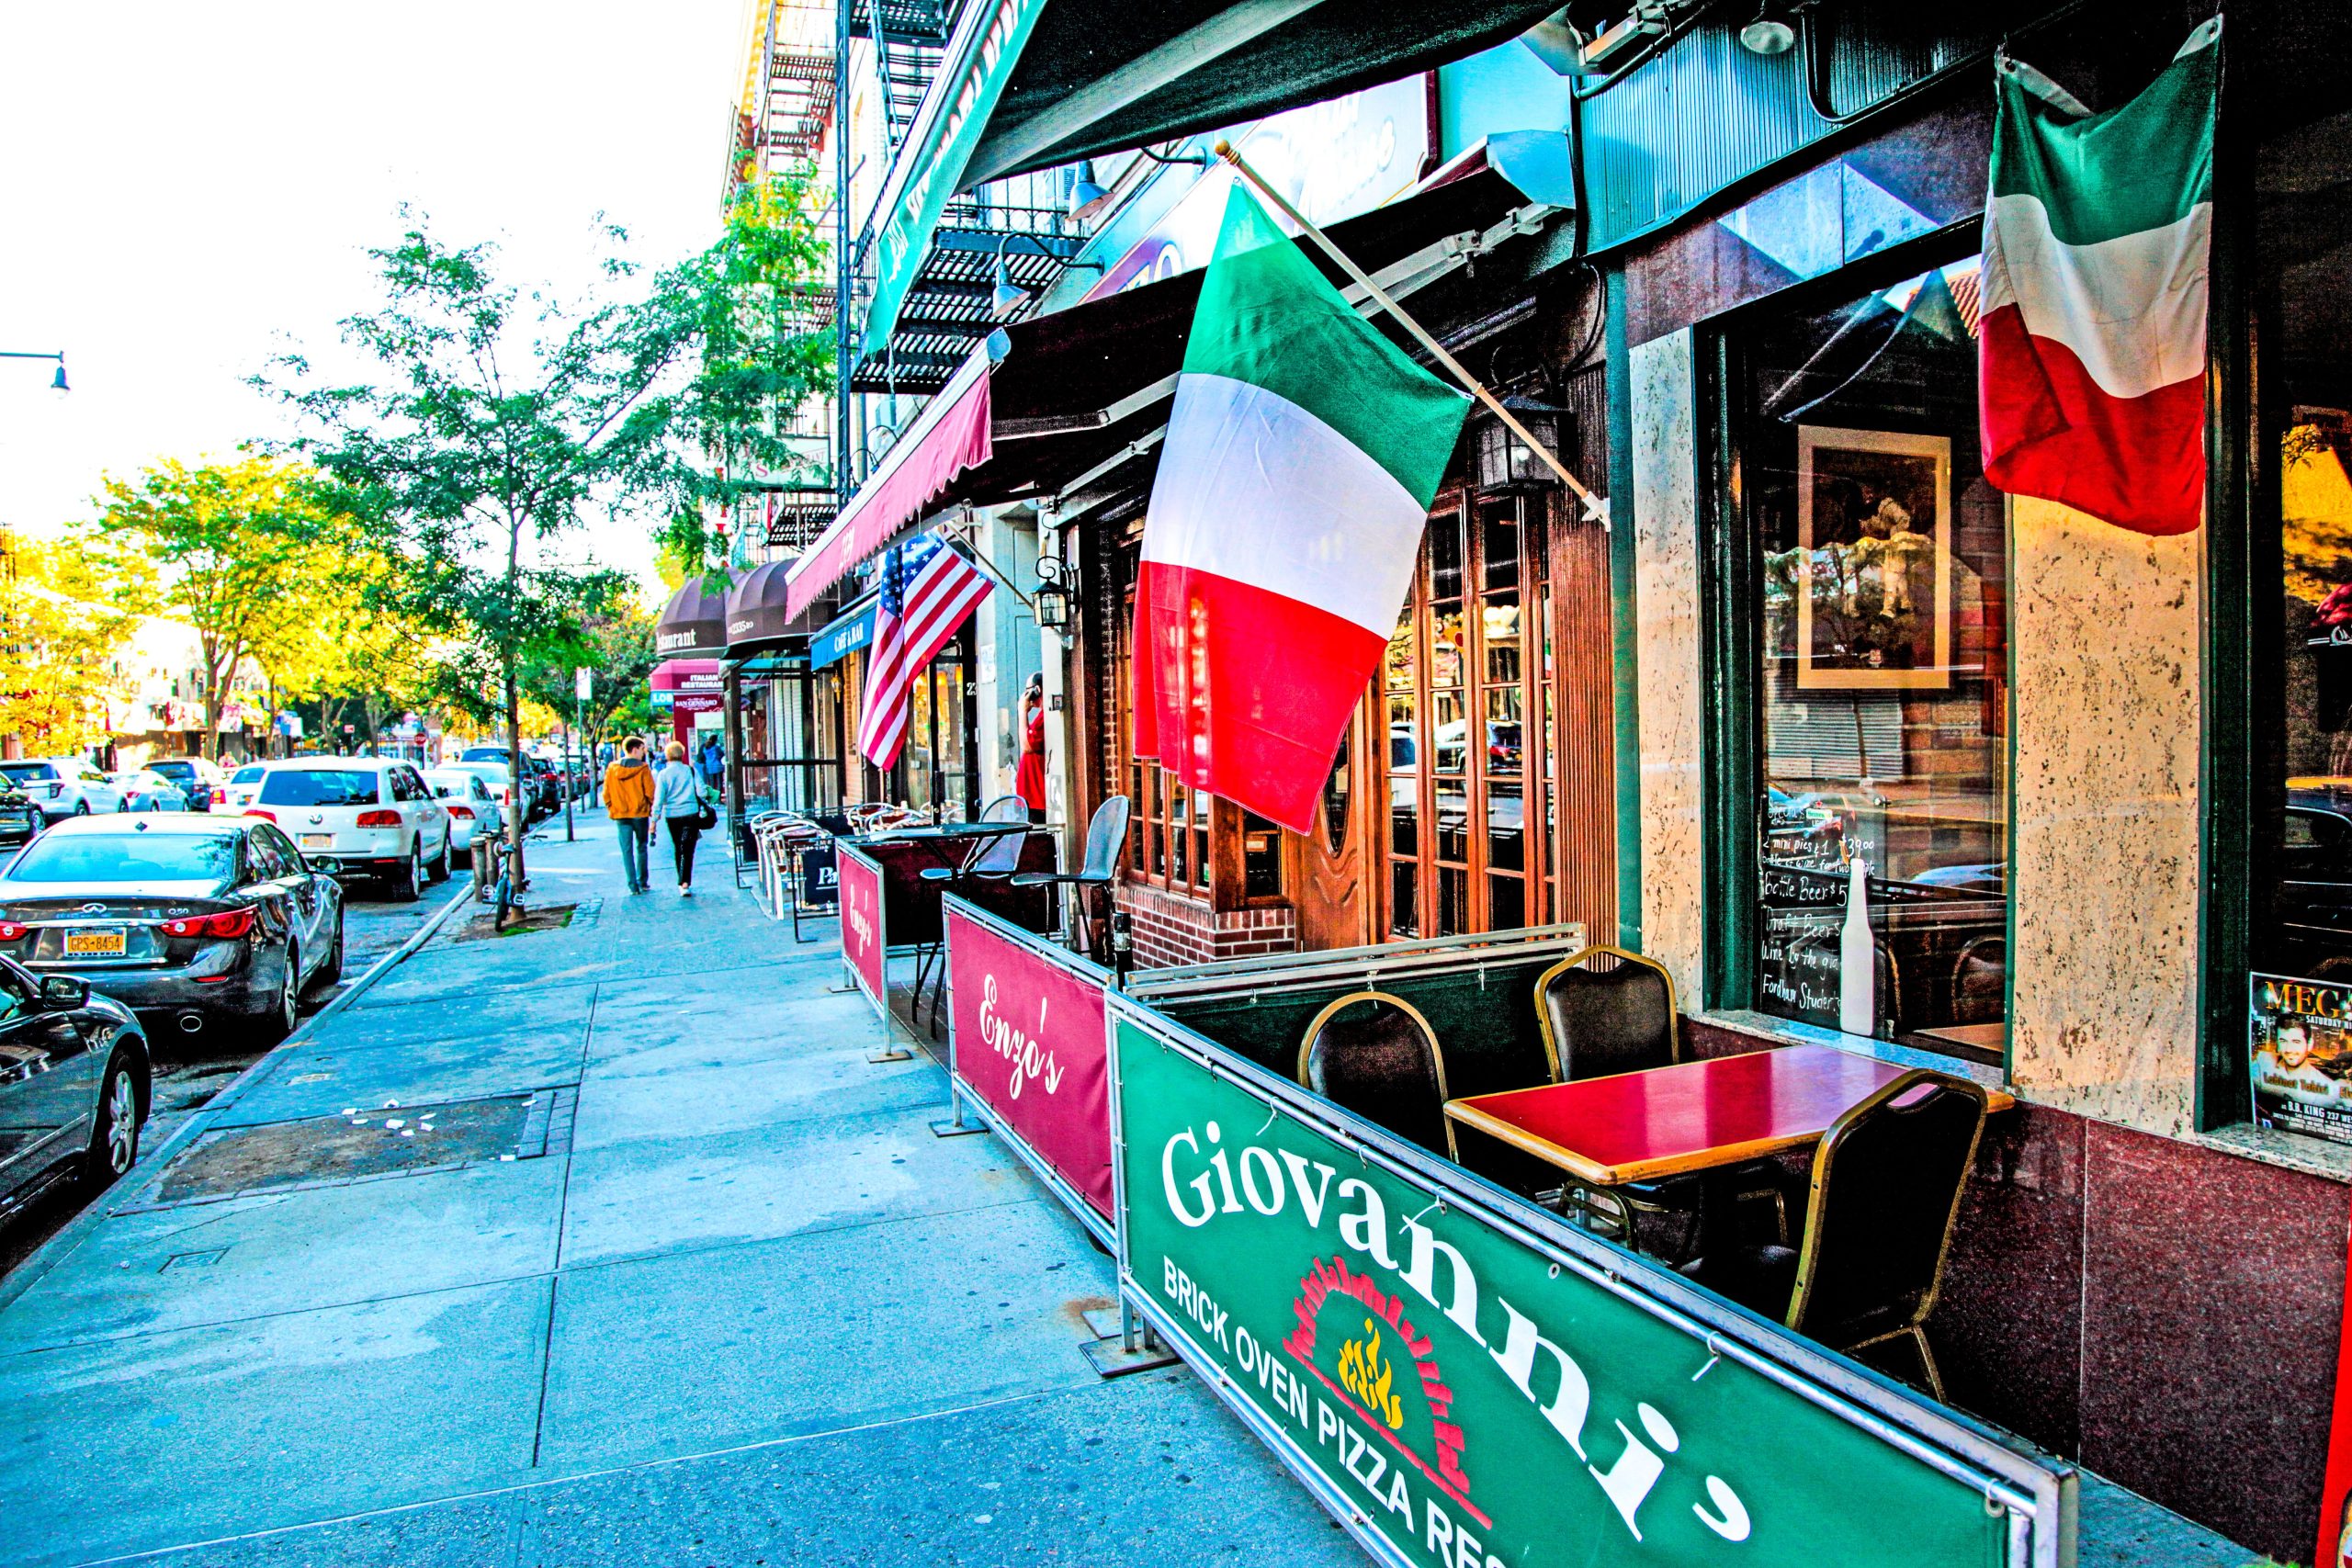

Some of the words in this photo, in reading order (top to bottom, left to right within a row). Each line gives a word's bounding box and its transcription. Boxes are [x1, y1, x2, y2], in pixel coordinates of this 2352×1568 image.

[681, 681, 724, 689] RESTAURAN
[1762, 974, 1797, 1003] Fordham
[2306, 1014, 2341, 1028] SATURDAY
[979, 974, 1065, 1100] Enzo's
[2303, 1103, 2325, 1118] KING
[2326, 1111, 2340, 1121] 237
[1163, 1255, 1229, 1355] BRICK
[1235, 1325, 1308, 1429] OVEN
[1317, 1397, 1415, 1534] PIZZA
